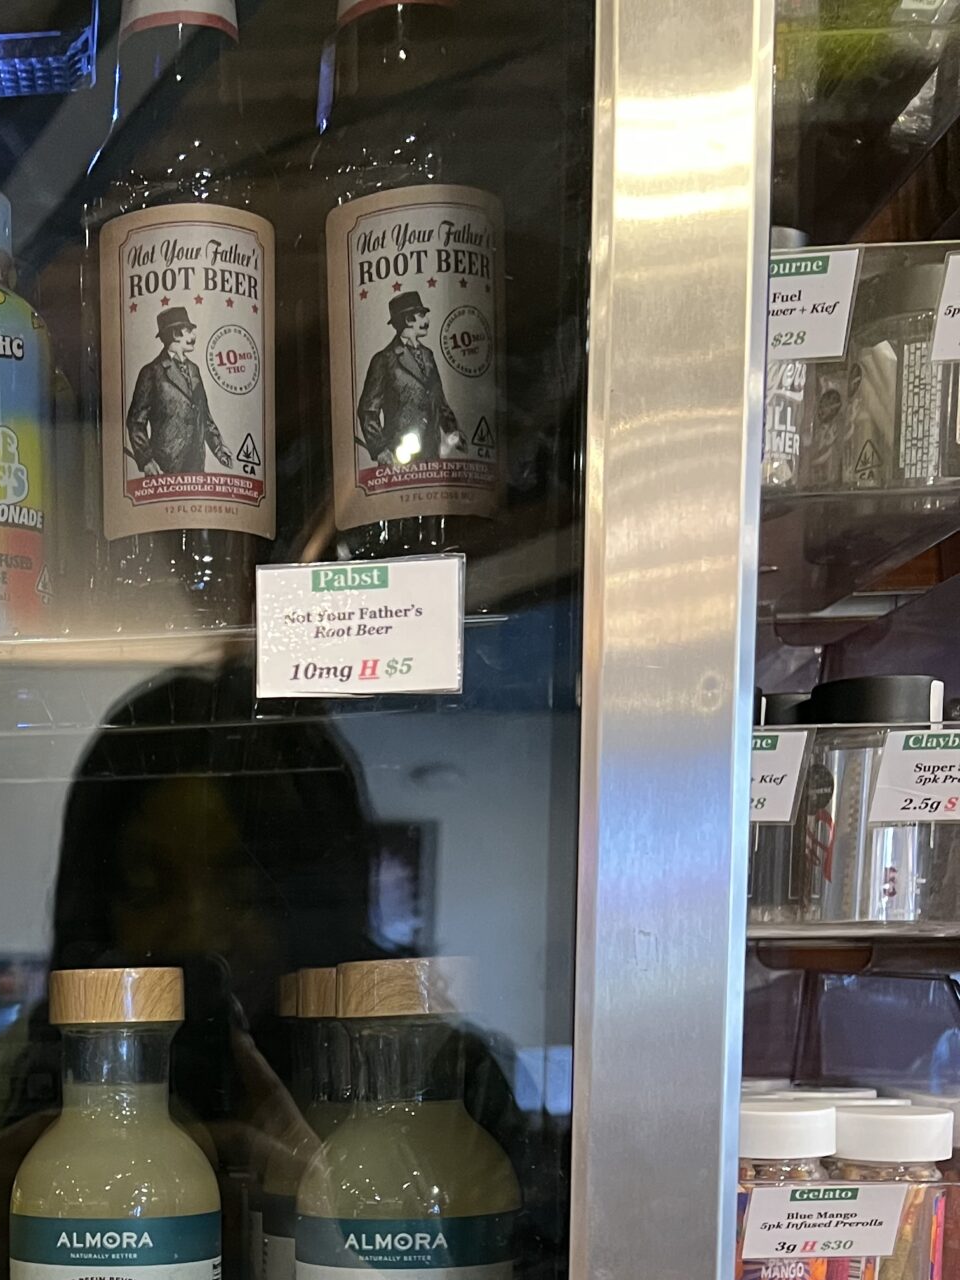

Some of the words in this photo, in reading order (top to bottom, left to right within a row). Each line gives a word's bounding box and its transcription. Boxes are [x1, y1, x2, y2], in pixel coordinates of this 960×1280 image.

[127, 245, 155, 269] Not
[160, 239, 201, 267] Your
[206, 240, 259, 271] Father's
[129, 267, 195, 299] ROOT
[204, 268, 258, 300] BEER
[773, 290, 801, 303] Fuel
[771, 331, 806, 348] $28
[135, 489, 154, 497] NON
[157, 484, 214, 493] ALCOHOLIC
[215, 485, 259, 498] BEVERAGE
[143, 476, 252, 491] CANNABIS-INFUSED
[319, 567, 382, 587] Pabst
[285, 612, 312, 624] Not
[318, 610, 355, 622] Your
[359, 604, 422, 619] Father's
[314, 626, 352, 638] Root
[356, 624, 392, 636] Beer
[913, 761, 954, 774] Super
[901, 798, 941, 812] 2.5g
[944, 797, 958, 811] S
[795, 1188, 852, 1199] Gelato
[761, 1222, 782, 1231] 5pk
[786, 1220, 832, 1230] Infused
[835, 1219, 883, 1227] Prerolls
[57, 1232, 153, 1248] ALMORA
[775, 1242, 797, 1253] 3g
[821, 1240, 853, 1251] $30
[761, 1263, 804, 1279] MANGO
